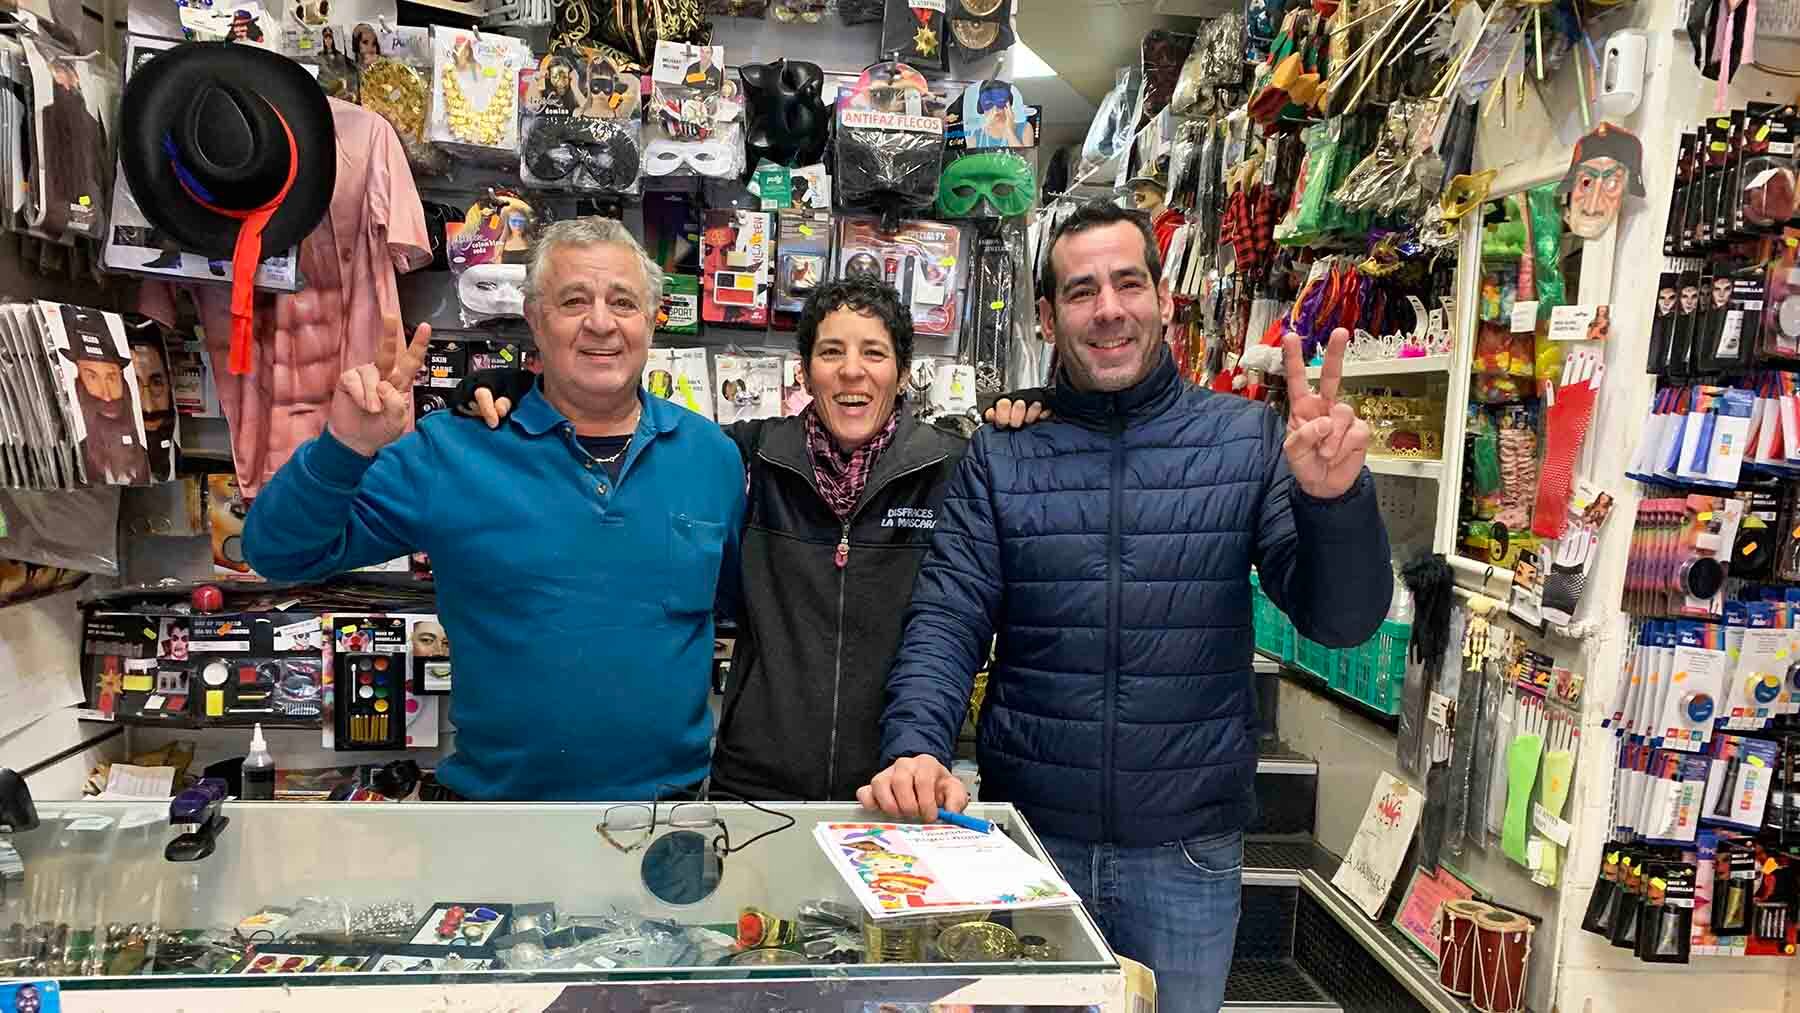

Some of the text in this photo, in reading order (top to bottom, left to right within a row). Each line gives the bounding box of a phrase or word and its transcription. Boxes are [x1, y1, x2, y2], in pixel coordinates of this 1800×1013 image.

[845, 111, 940, 130] ANTIFAZ FLECOS
[669, 307, 692, 317] SPORT
[431, 356, 447, 364] SKIN
[887, 508, 934, 519] DISFRACES
[881, 518, 894, 527] LA
